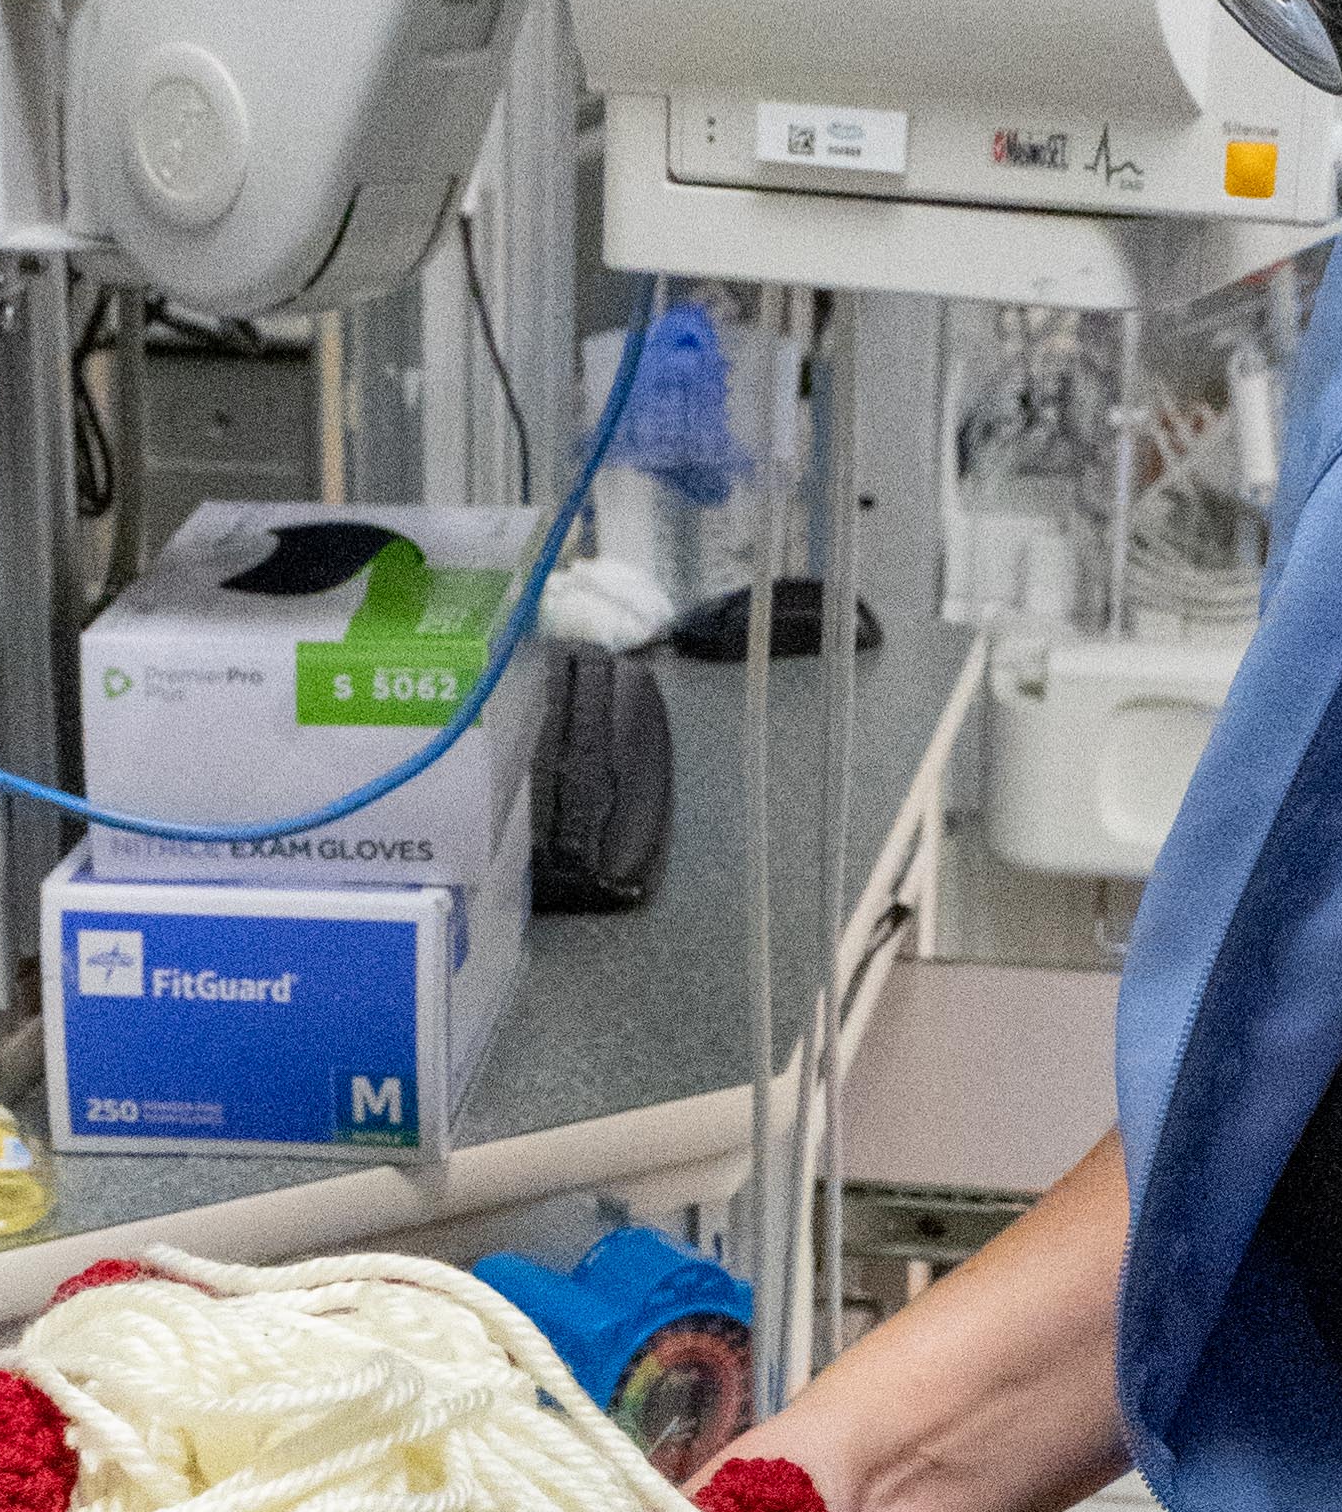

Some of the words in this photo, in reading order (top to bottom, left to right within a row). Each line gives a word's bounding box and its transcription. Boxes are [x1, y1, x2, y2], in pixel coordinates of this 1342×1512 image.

[333, 674, 353, 700] S
[371, 672, 458, 701] 5062
[229, 838, 312, 860] EXAM
[317, 839, 435, 863] GLOVES
[152, 969, 293, 1003] FitGuard
[86, 1098, 139, 1123] 250
[350, 1075, 403, 1125] M
